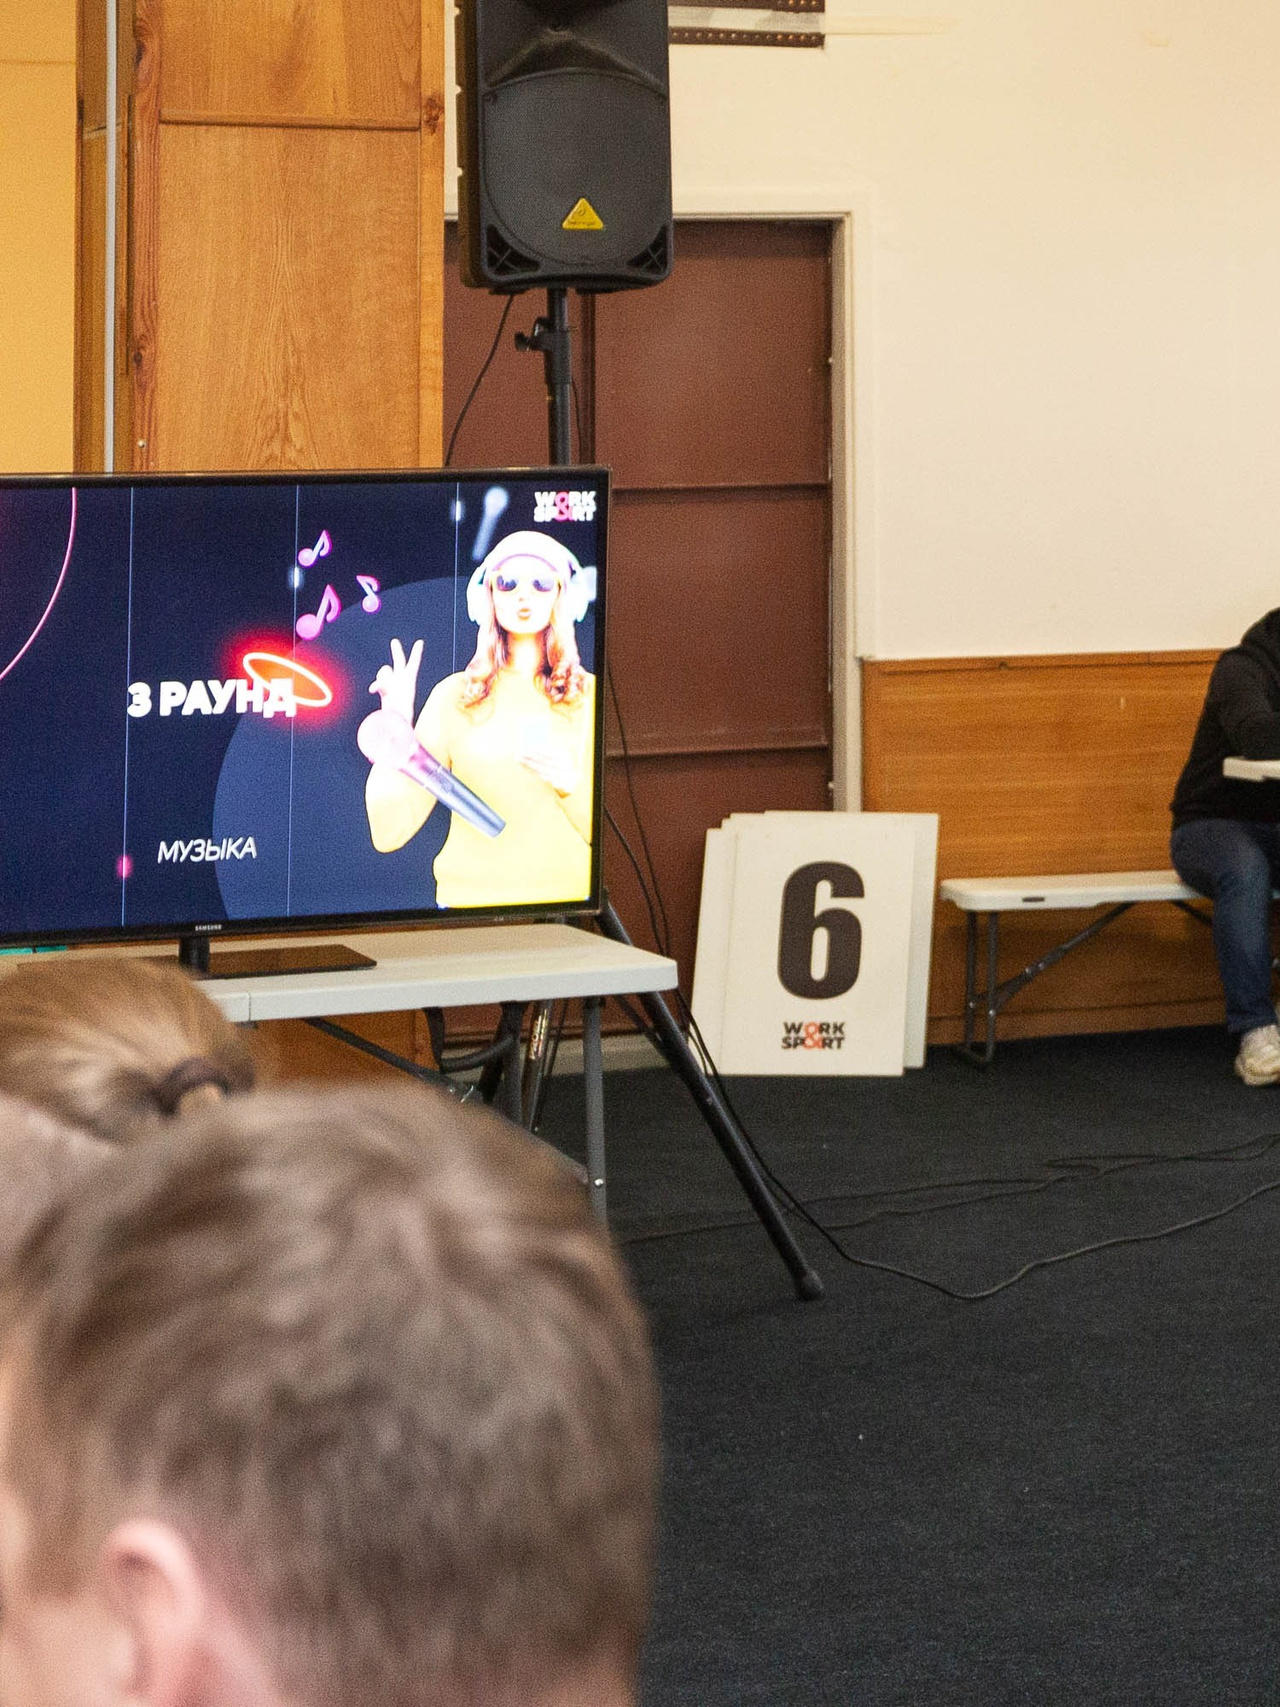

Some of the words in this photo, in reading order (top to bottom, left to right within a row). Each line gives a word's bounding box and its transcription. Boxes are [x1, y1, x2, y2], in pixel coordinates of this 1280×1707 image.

[127, 682, 152, 718] 3
[159, 678, 297, 718] РАУНД
[157, 836, 257, 864] МУЗЫКА
[777, 861, 865, 1001] 6
